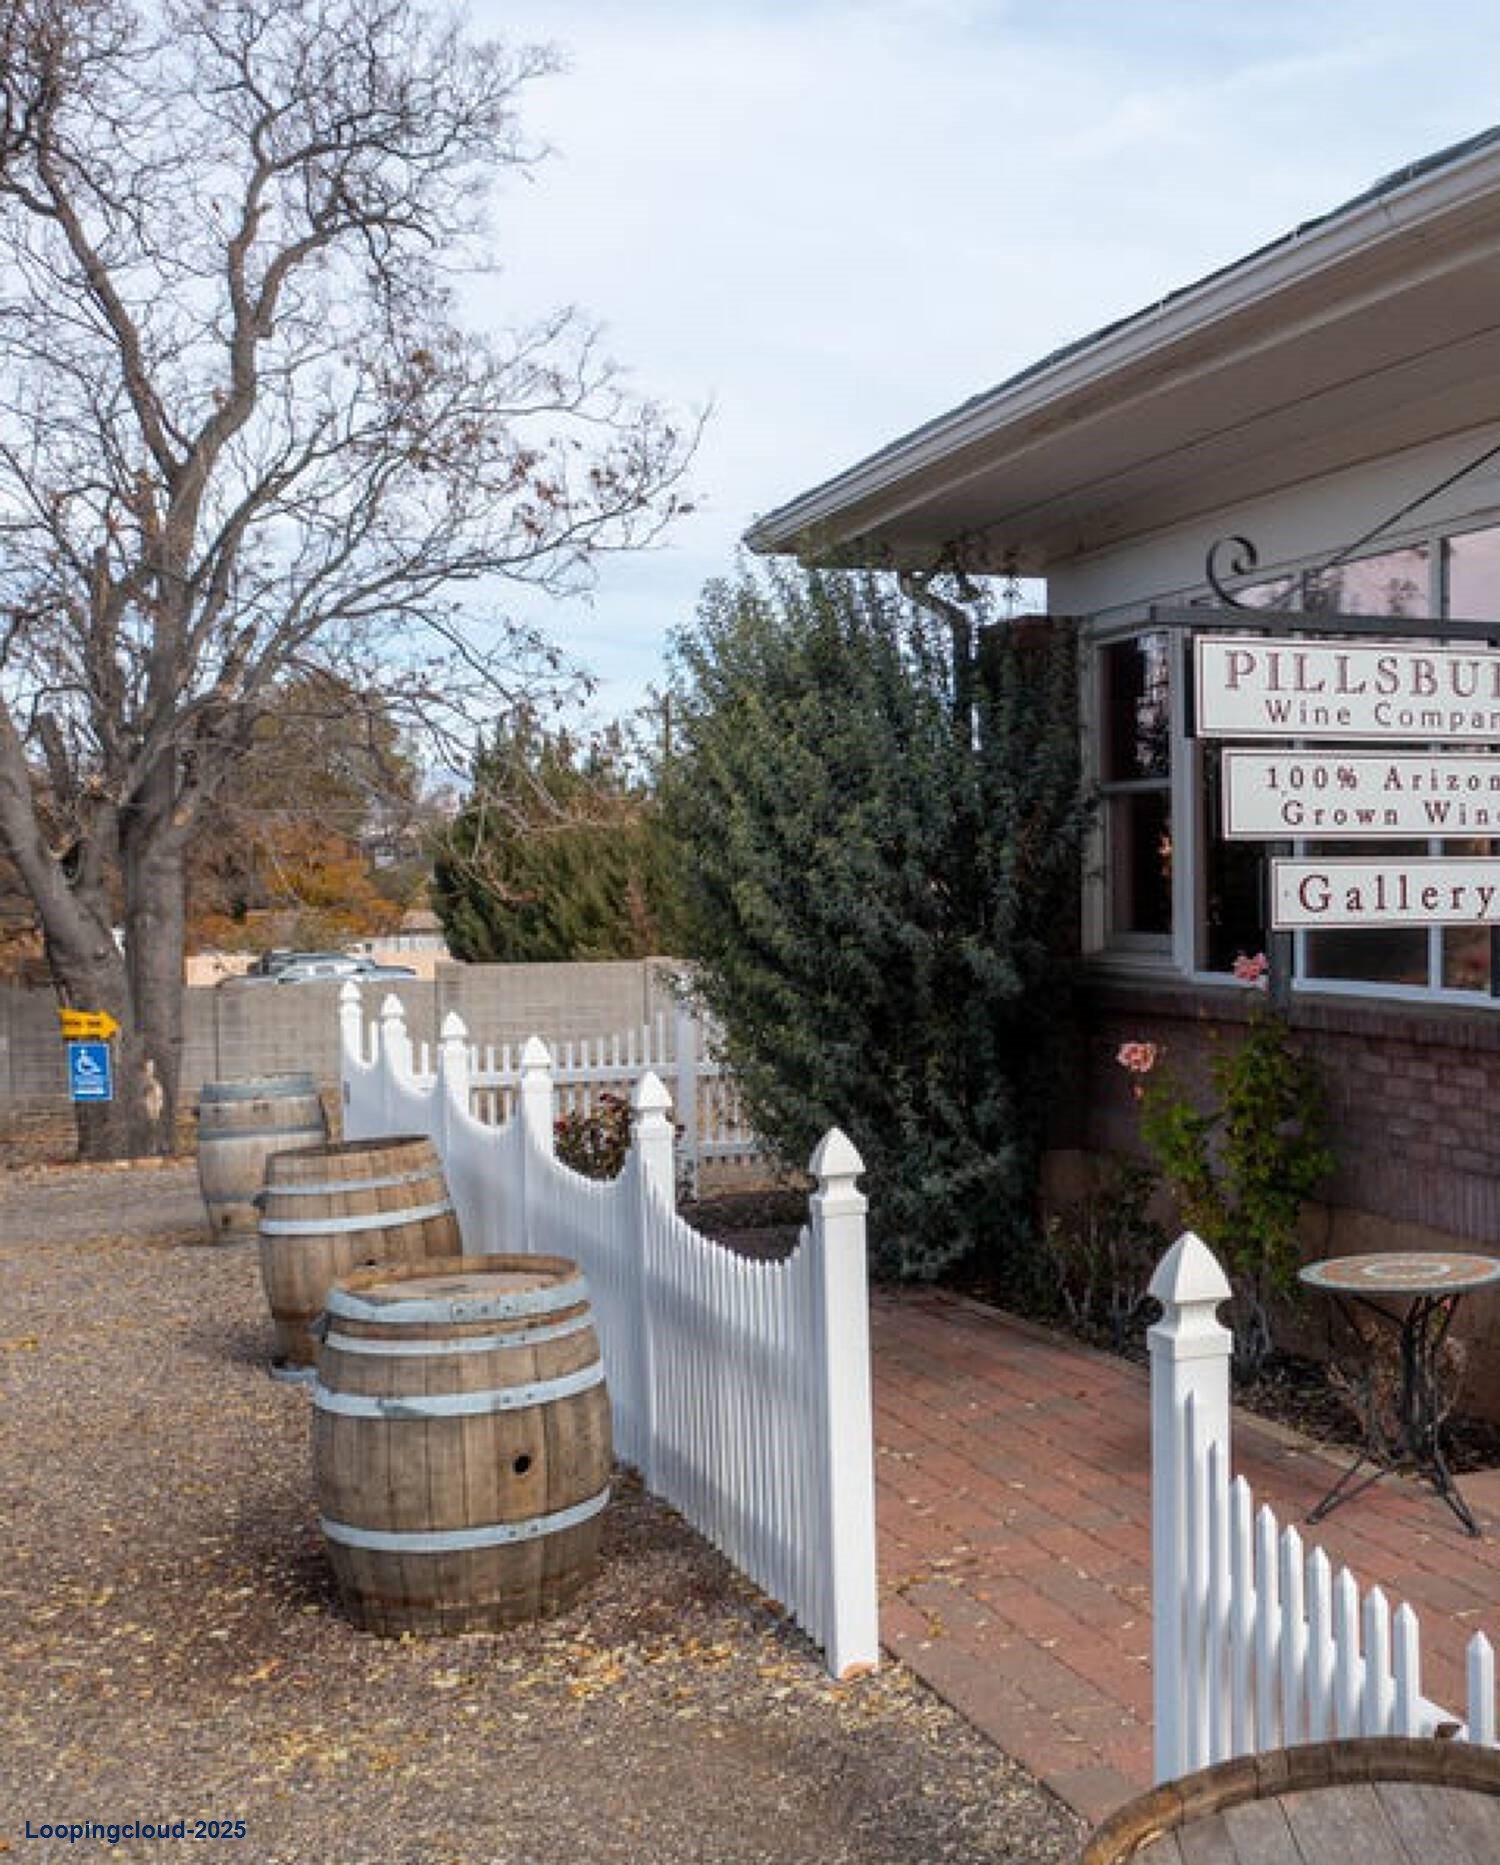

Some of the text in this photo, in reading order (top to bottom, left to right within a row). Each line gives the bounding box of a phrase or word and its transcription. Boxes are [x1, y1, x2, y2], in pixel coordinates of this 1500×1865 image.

[1265, 700, 1351, 726] Wine
[1267, 766, 1358, 790] 100%
[1281, 800, 1399, 827] Grown
[1298, 874, 1497, 918] Gallery
